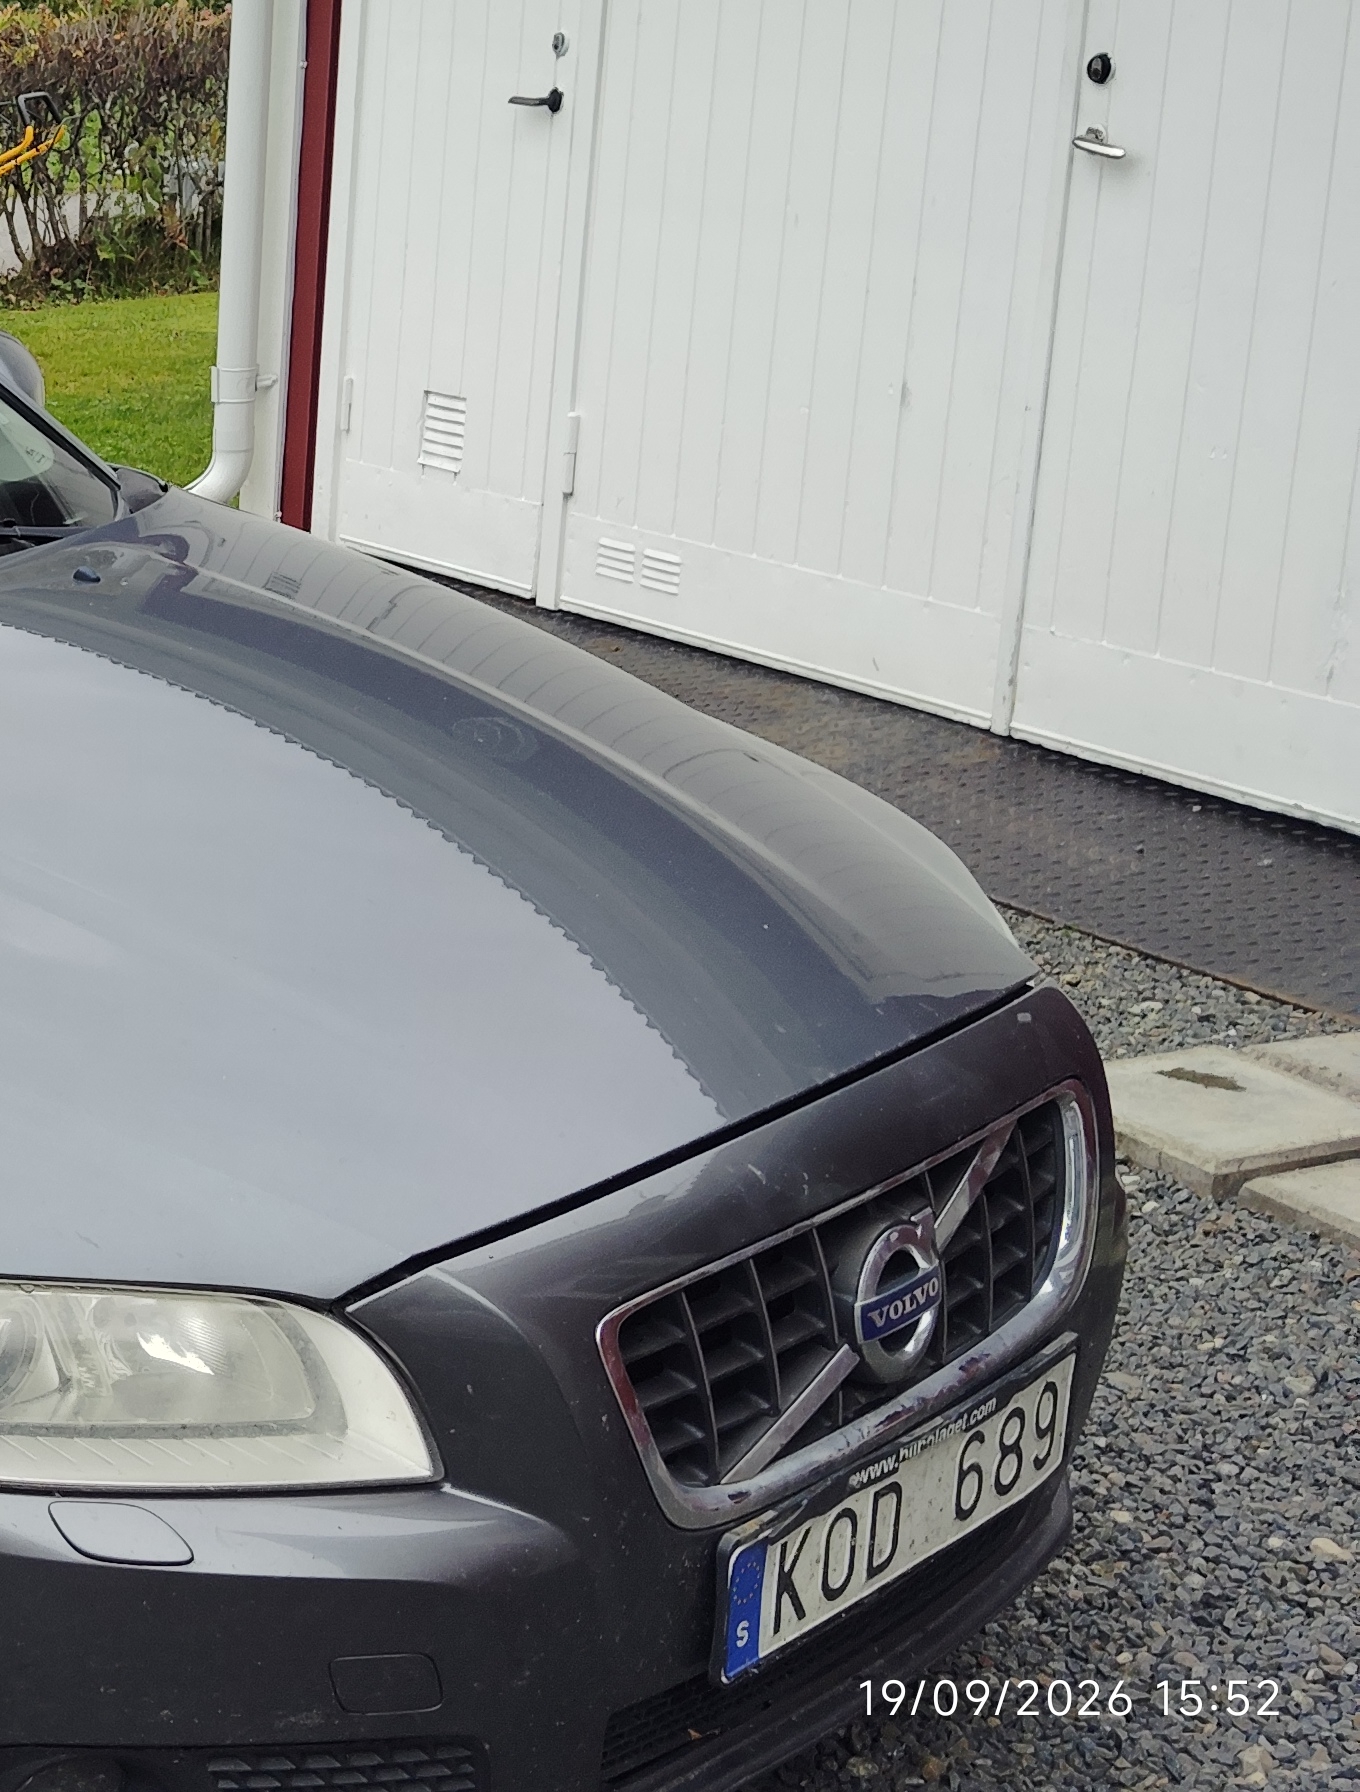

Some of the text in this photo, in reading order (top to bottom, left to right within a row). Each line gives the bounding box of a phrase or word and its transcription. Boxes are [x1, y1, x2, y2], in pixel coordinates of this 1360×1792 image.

[868, 1277, 939, 1328] VOLVO
[773, 1380, 1059, 1636] KOD 689
[736, 1620, 750, 1647] S
